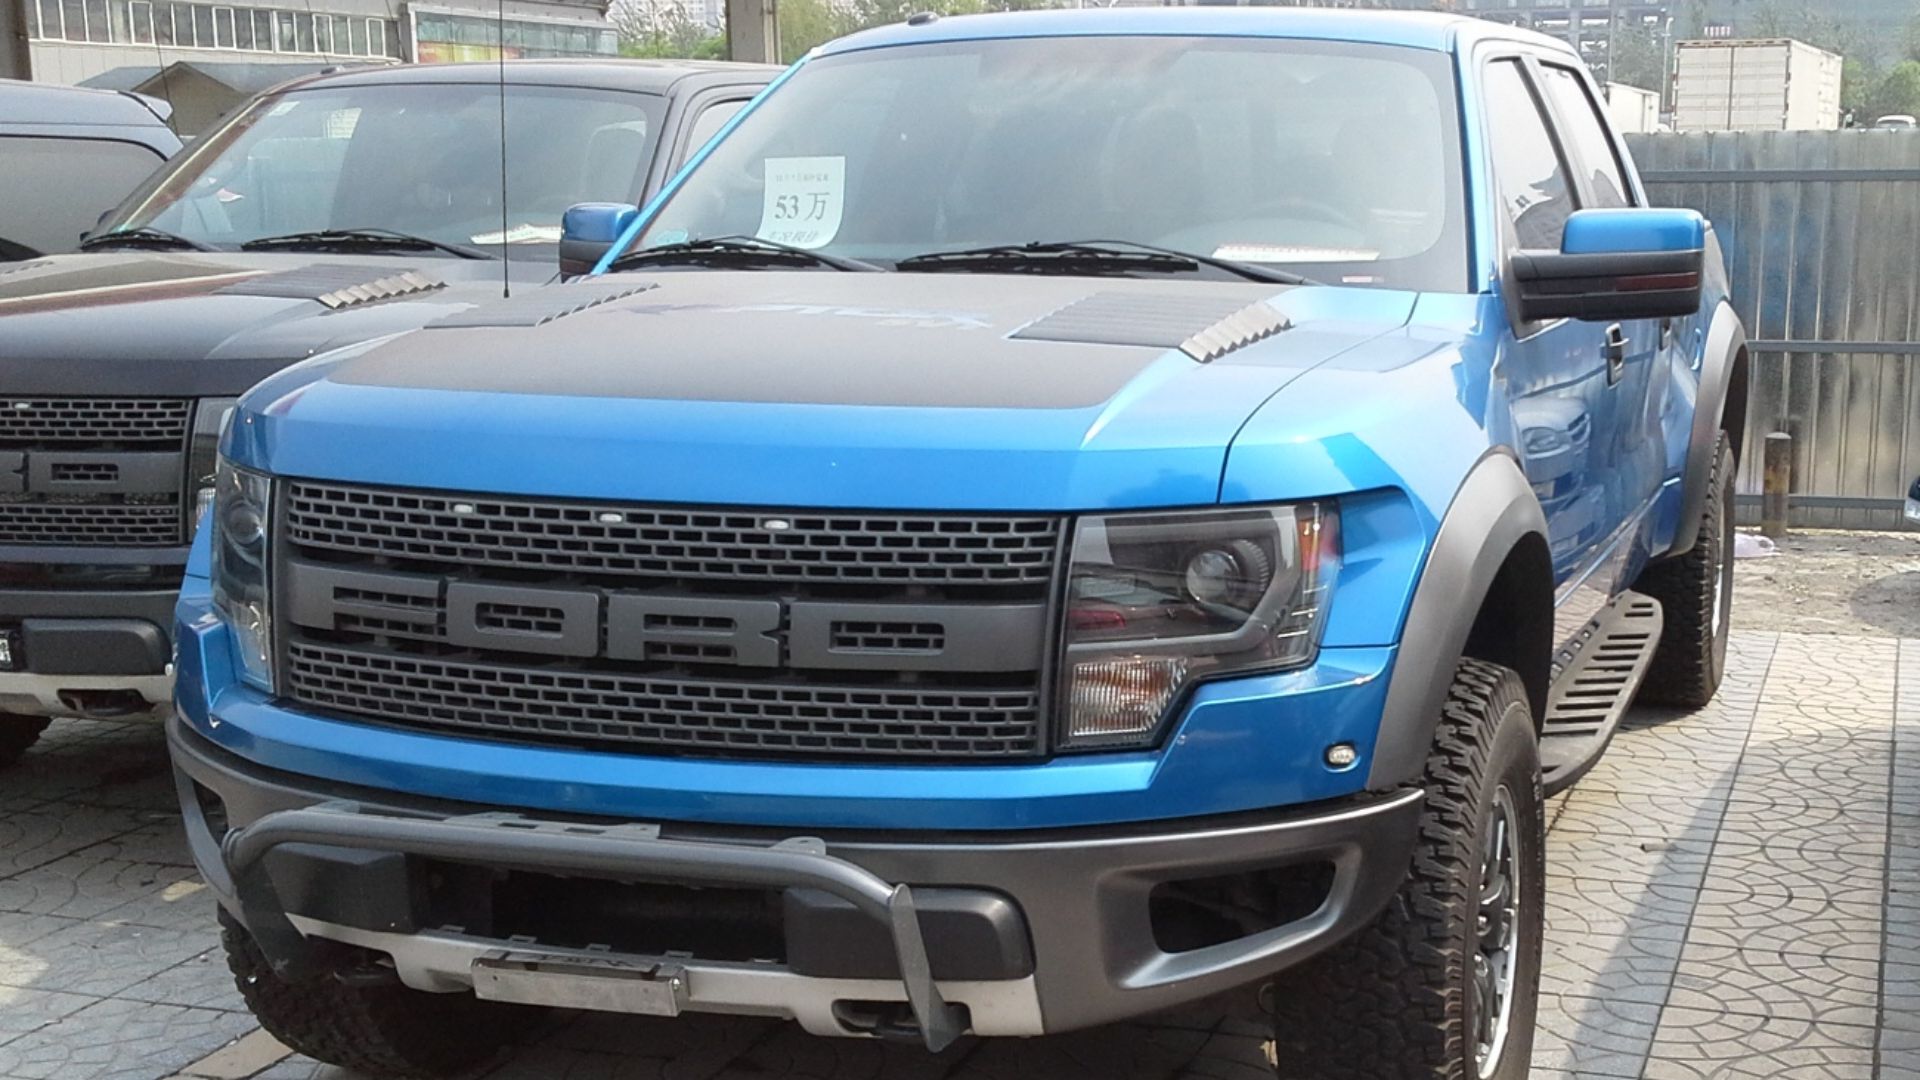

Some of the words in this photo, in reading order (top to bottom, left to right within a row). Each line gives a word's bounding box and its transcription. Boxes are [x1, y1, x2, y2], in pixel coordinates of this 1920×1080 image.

[775, 195, 800, 220] 53
[805, 192, 830, 221] 万
[289, 559, 1045, 672] FORD
